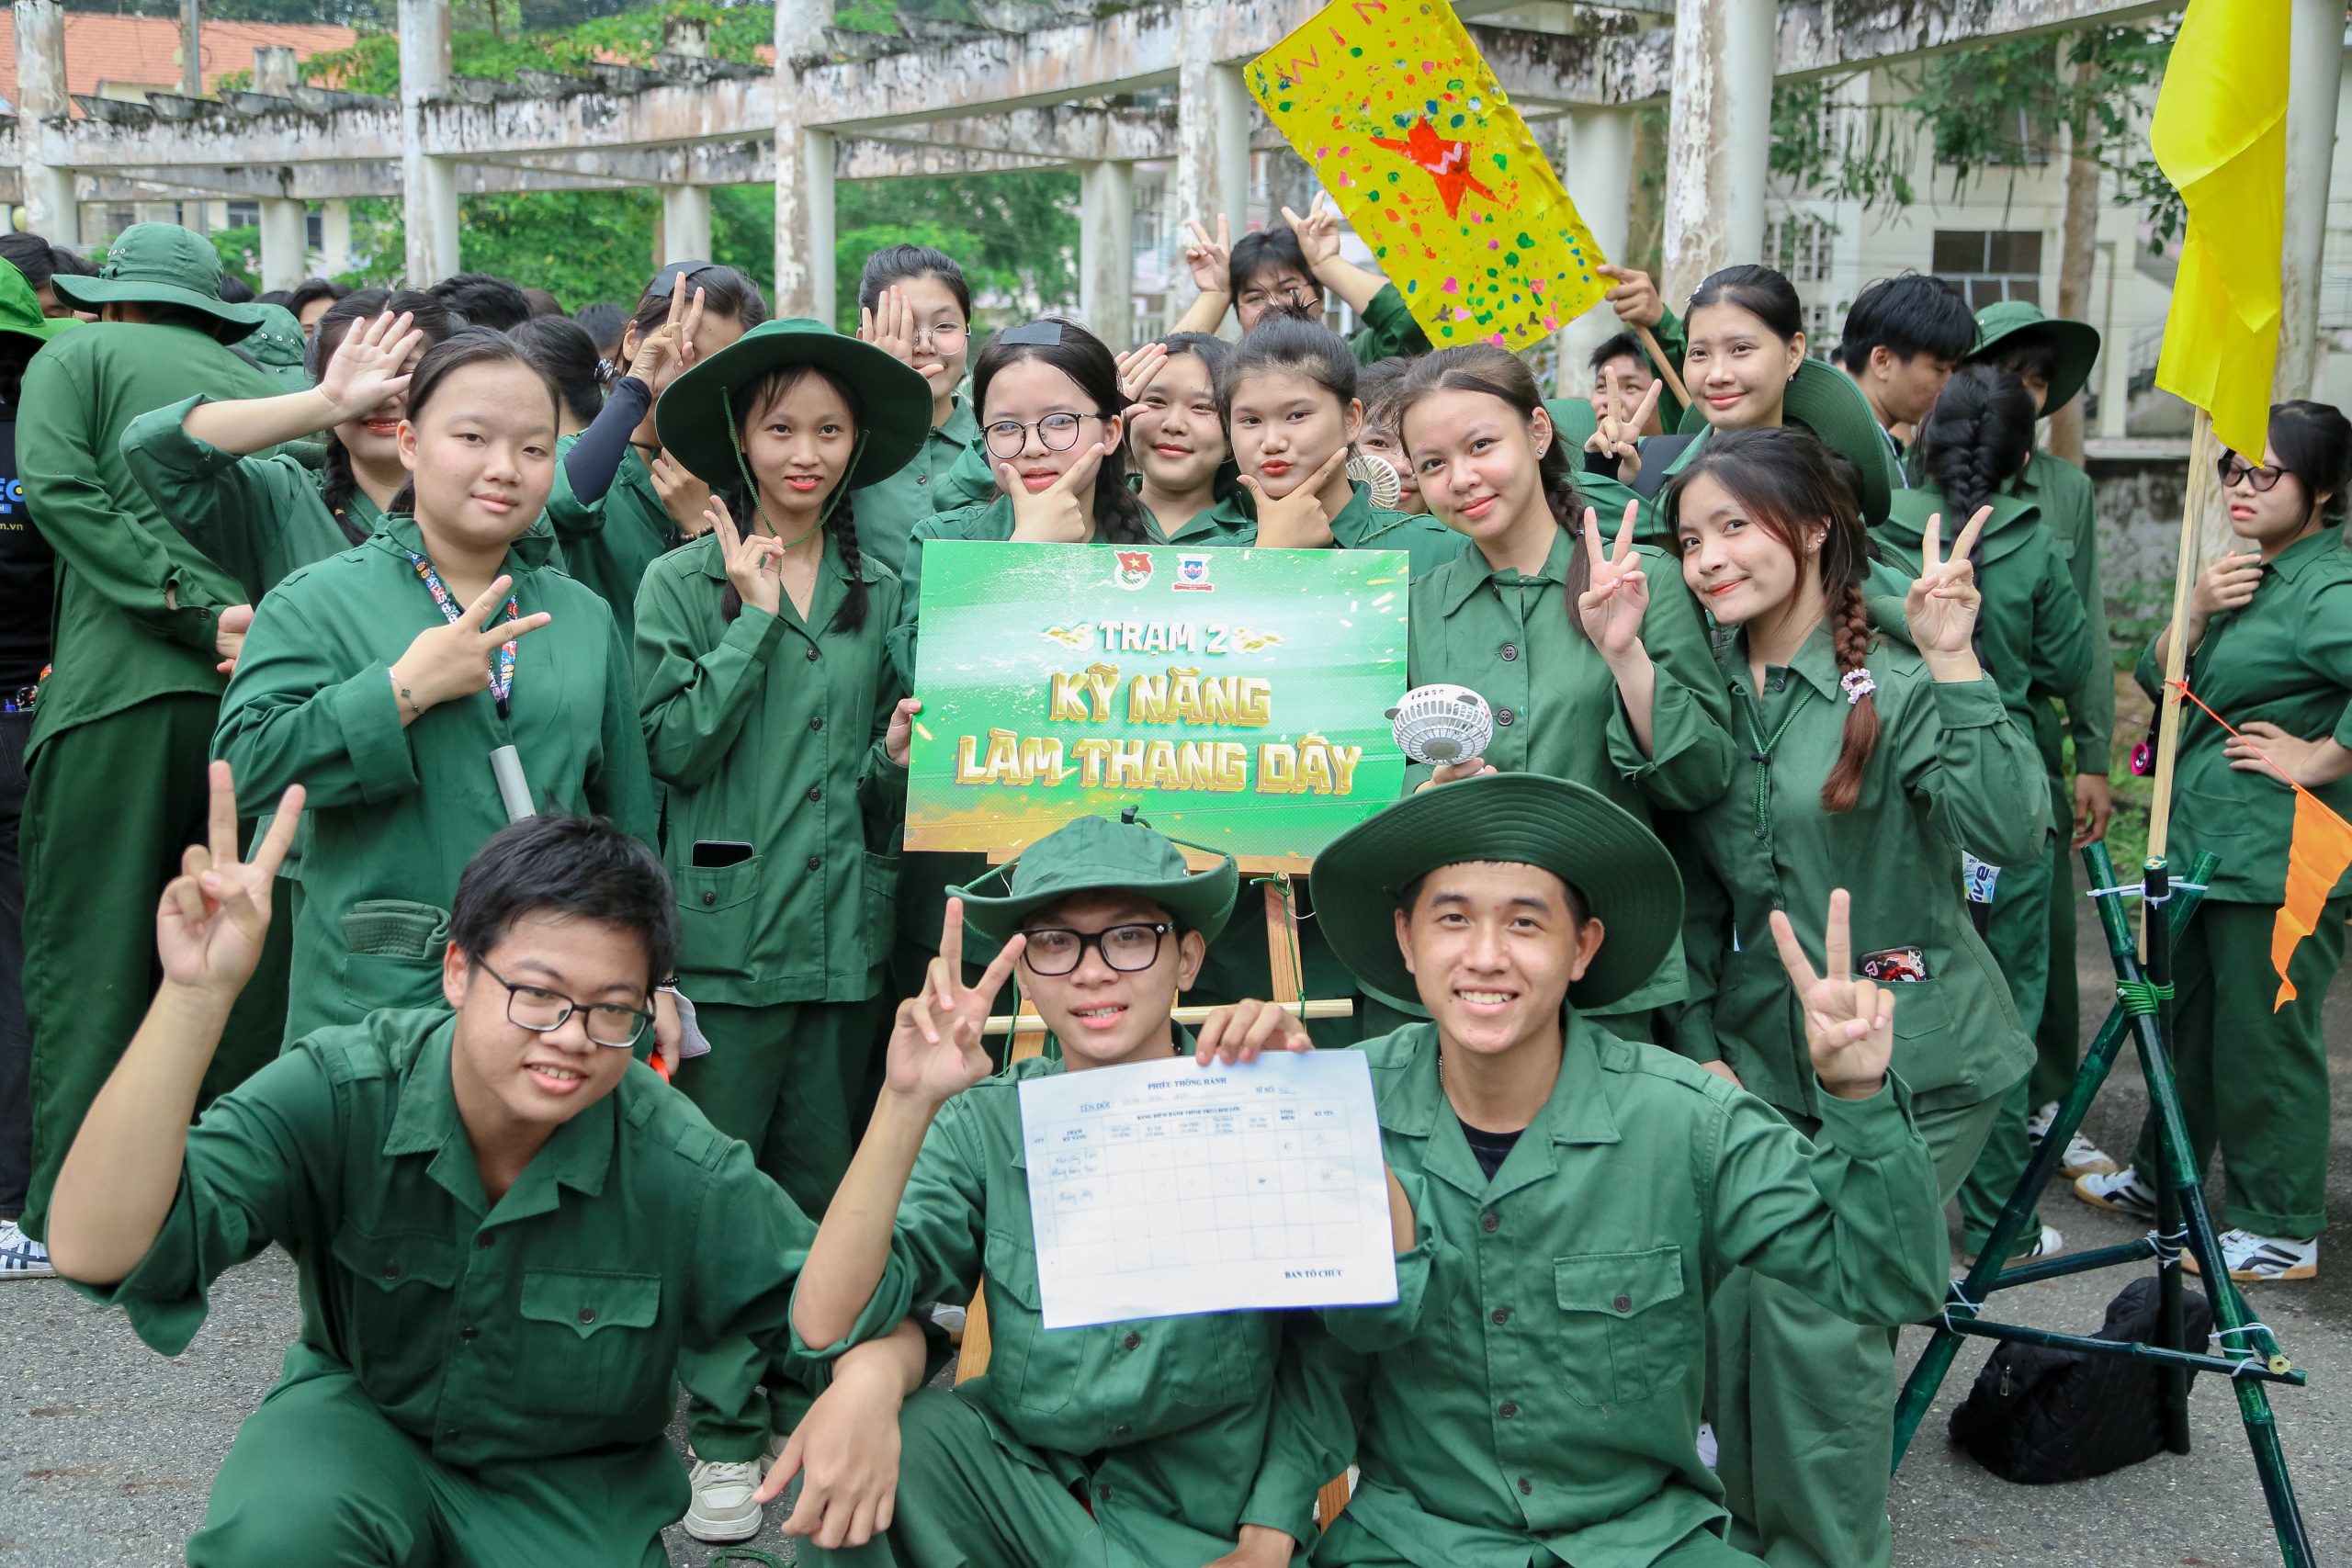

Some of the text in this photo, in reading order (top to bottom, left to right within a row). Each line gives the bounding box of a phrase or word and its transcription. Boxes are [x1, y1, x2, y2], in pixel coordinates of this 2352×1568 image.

[1097, 621, 1229, 656] TRẠM 2
[1049, 662, 1272, 727] KỸ NĂNG
[956, 728, 1363, 795] LÀM THANG DÂY
